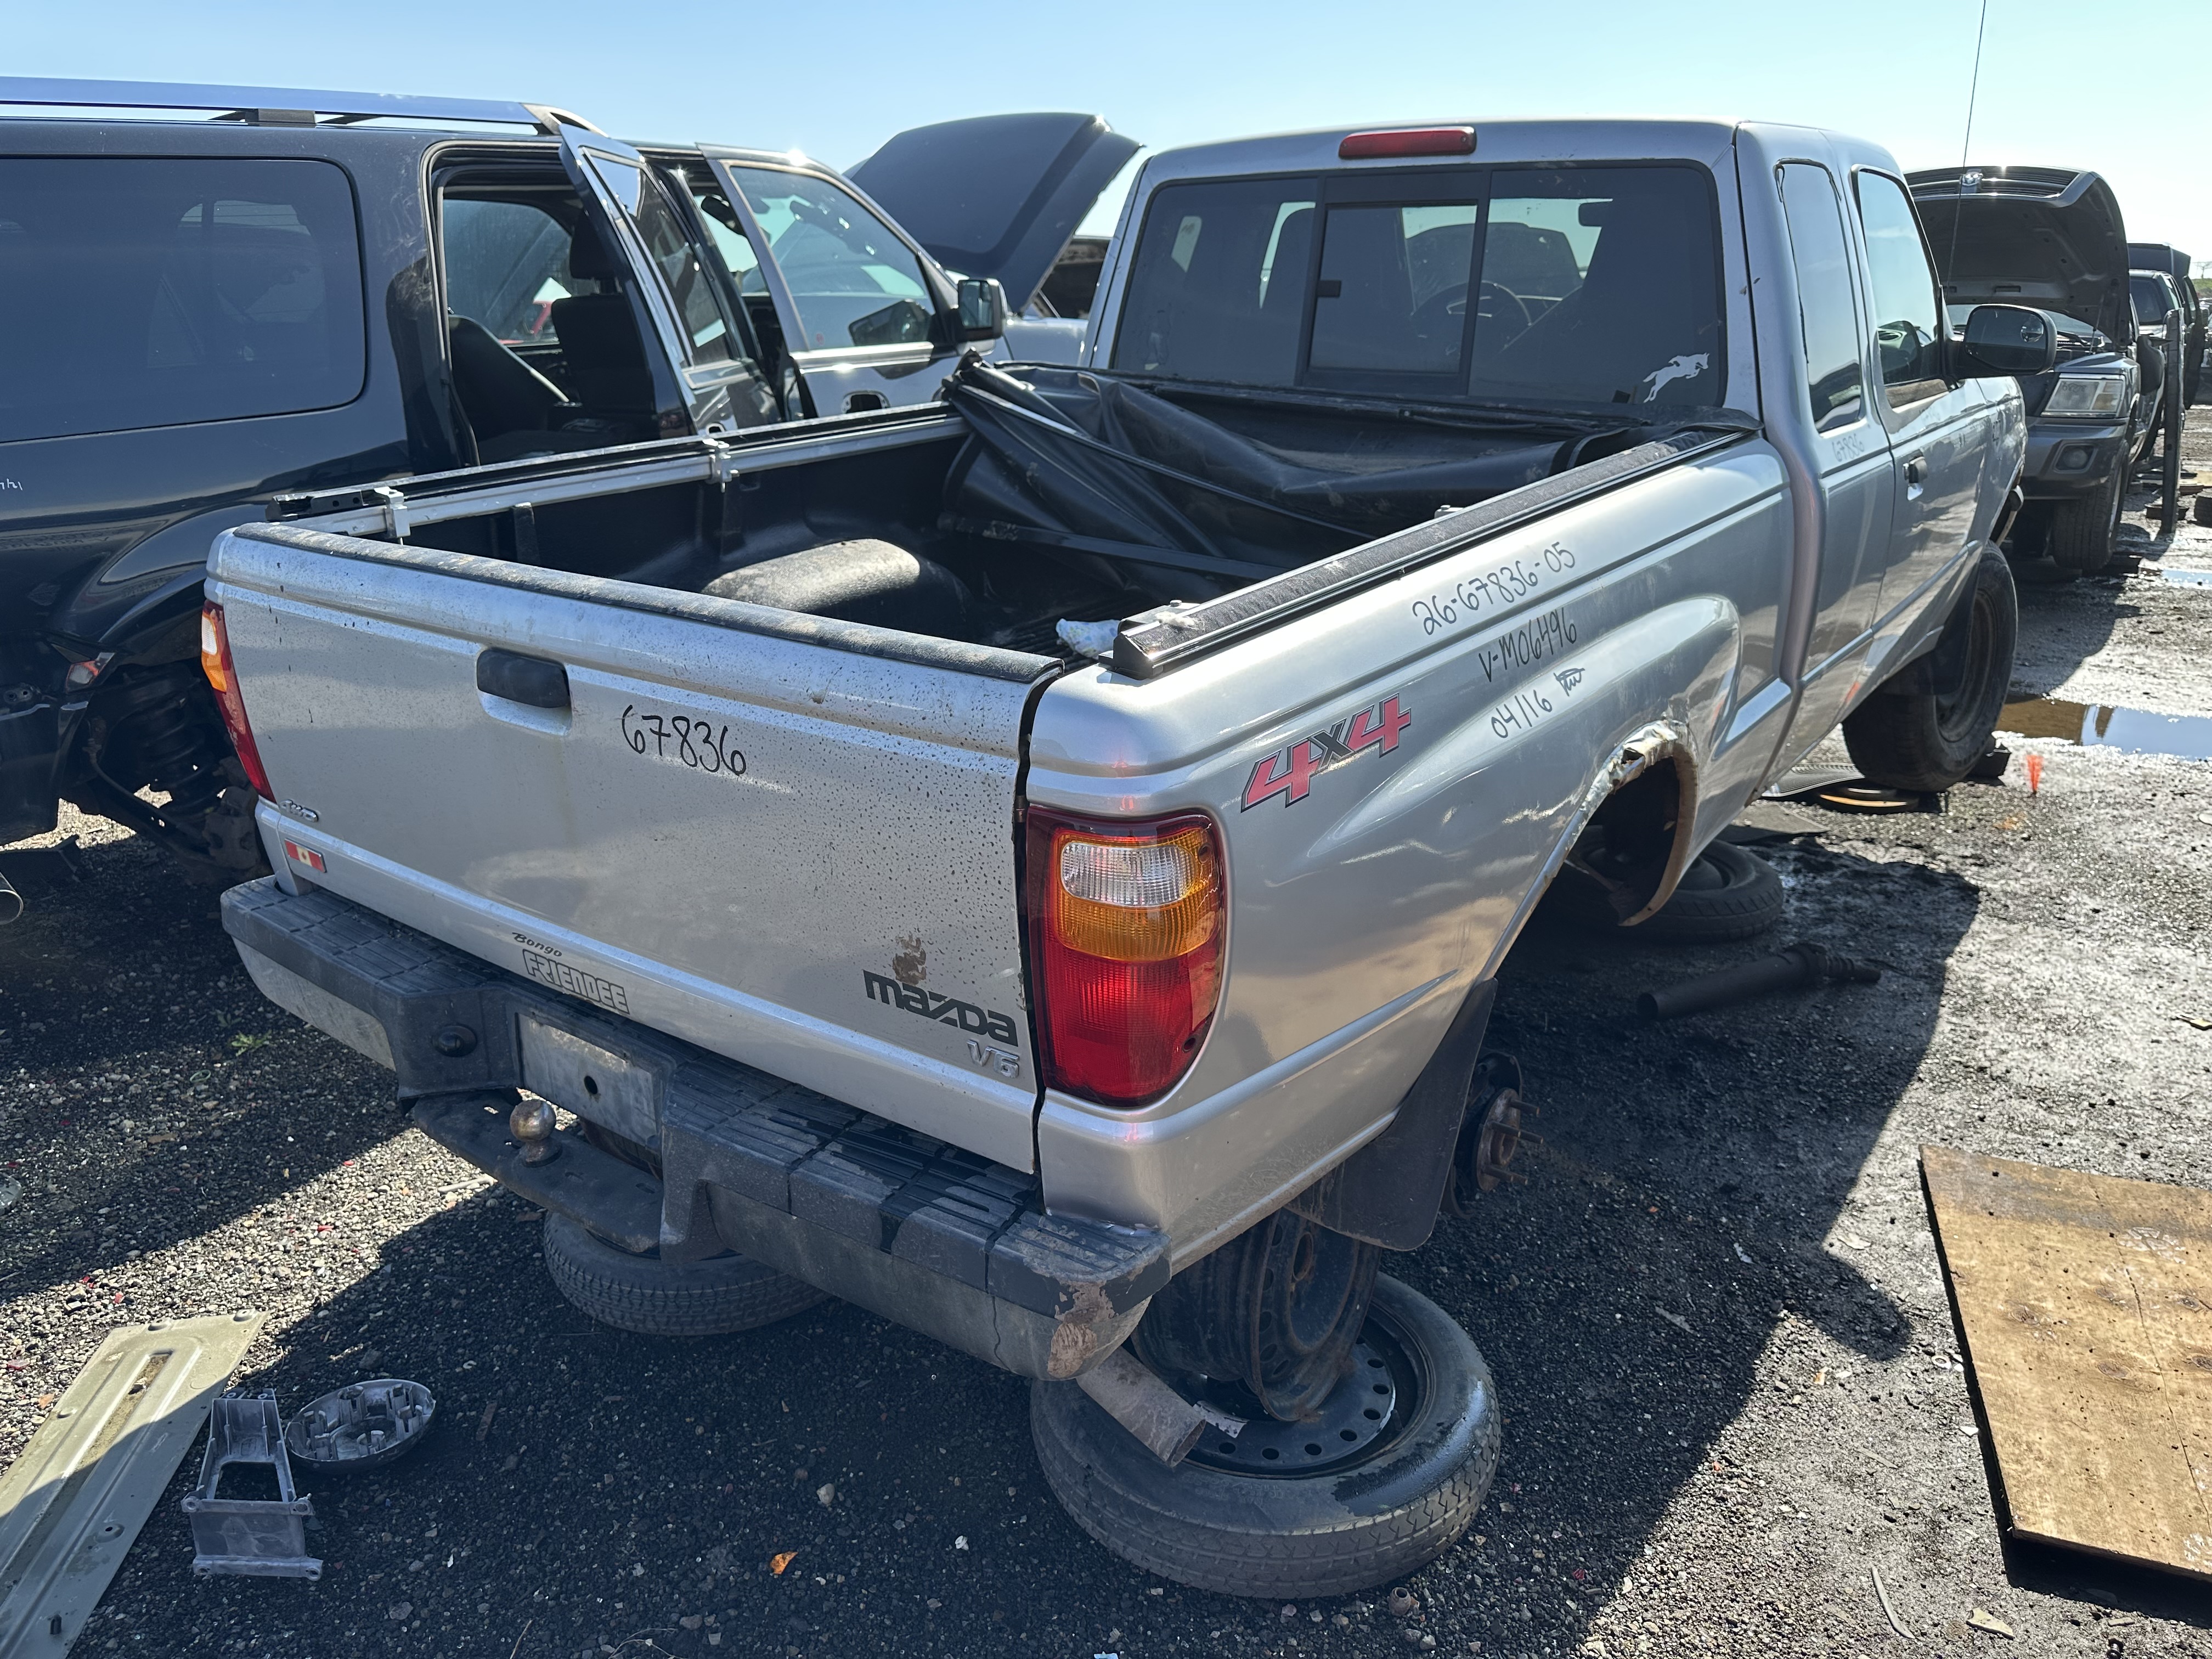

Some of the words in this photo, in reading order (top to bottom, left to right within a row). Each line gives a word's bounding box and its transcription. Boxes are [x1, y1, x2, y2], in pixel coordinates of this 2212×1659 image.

[1412, 541, 1576, 636] 26-67836-05
[1478, 607, 1577, 683] V-M06496
[621, 704, 747, 776] 67836
[1491, 689, 1553, 738] 04/16
[511, 932, 562, 957] Bongo
[522, 948, 631, 1015] FRIENDEE
[966, 1039, 1020, 1079] V6
